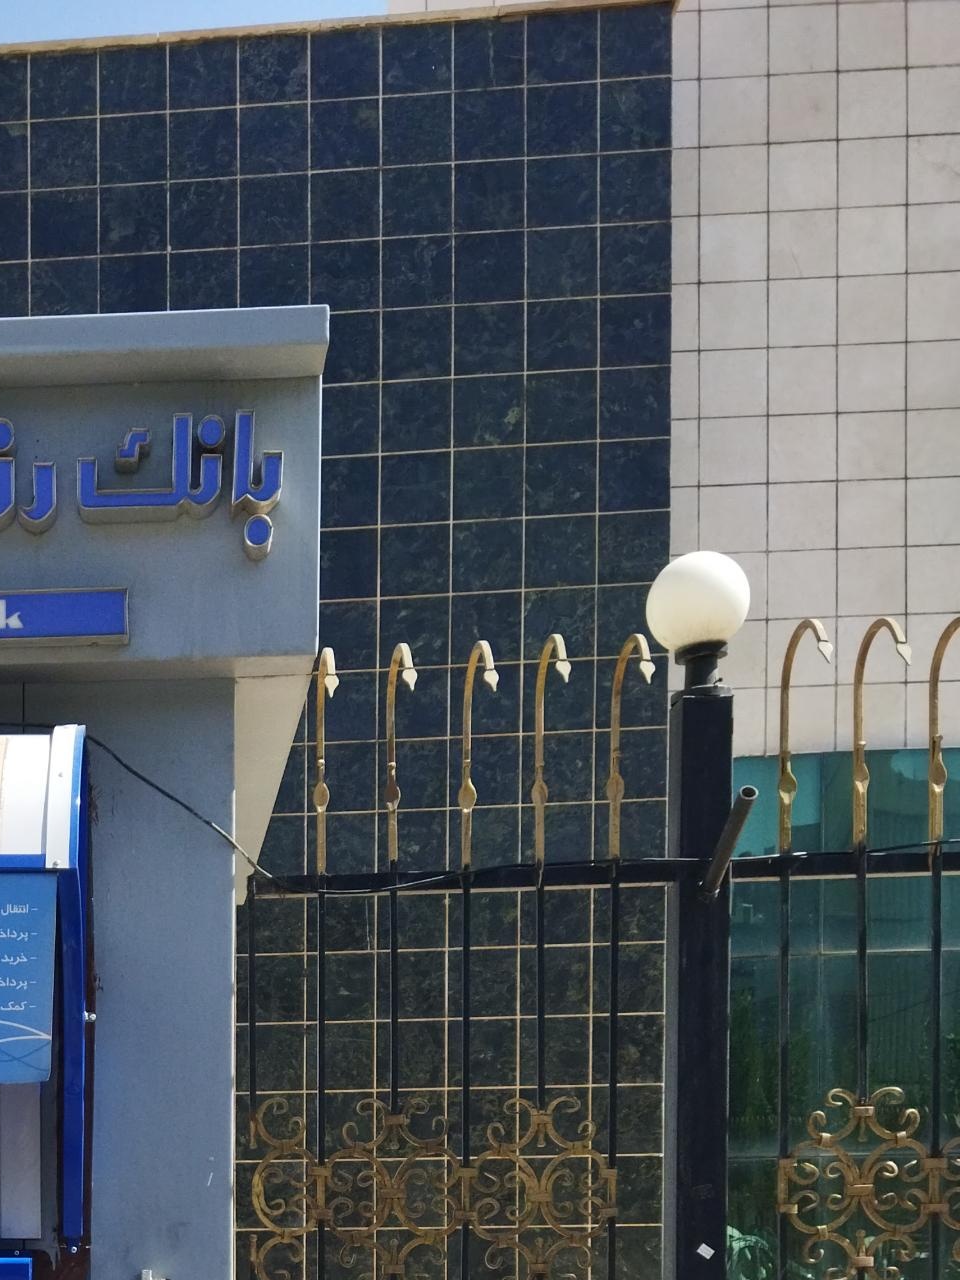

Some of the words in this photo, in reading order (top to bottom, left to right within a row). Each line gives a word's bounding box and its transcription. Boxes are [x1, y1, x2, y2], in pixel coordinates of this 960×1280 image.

[0, 903, 29, 917] انتقال
[1, 952, 28, 966] خرید
[0, 1000, 28, 1012] کمک
